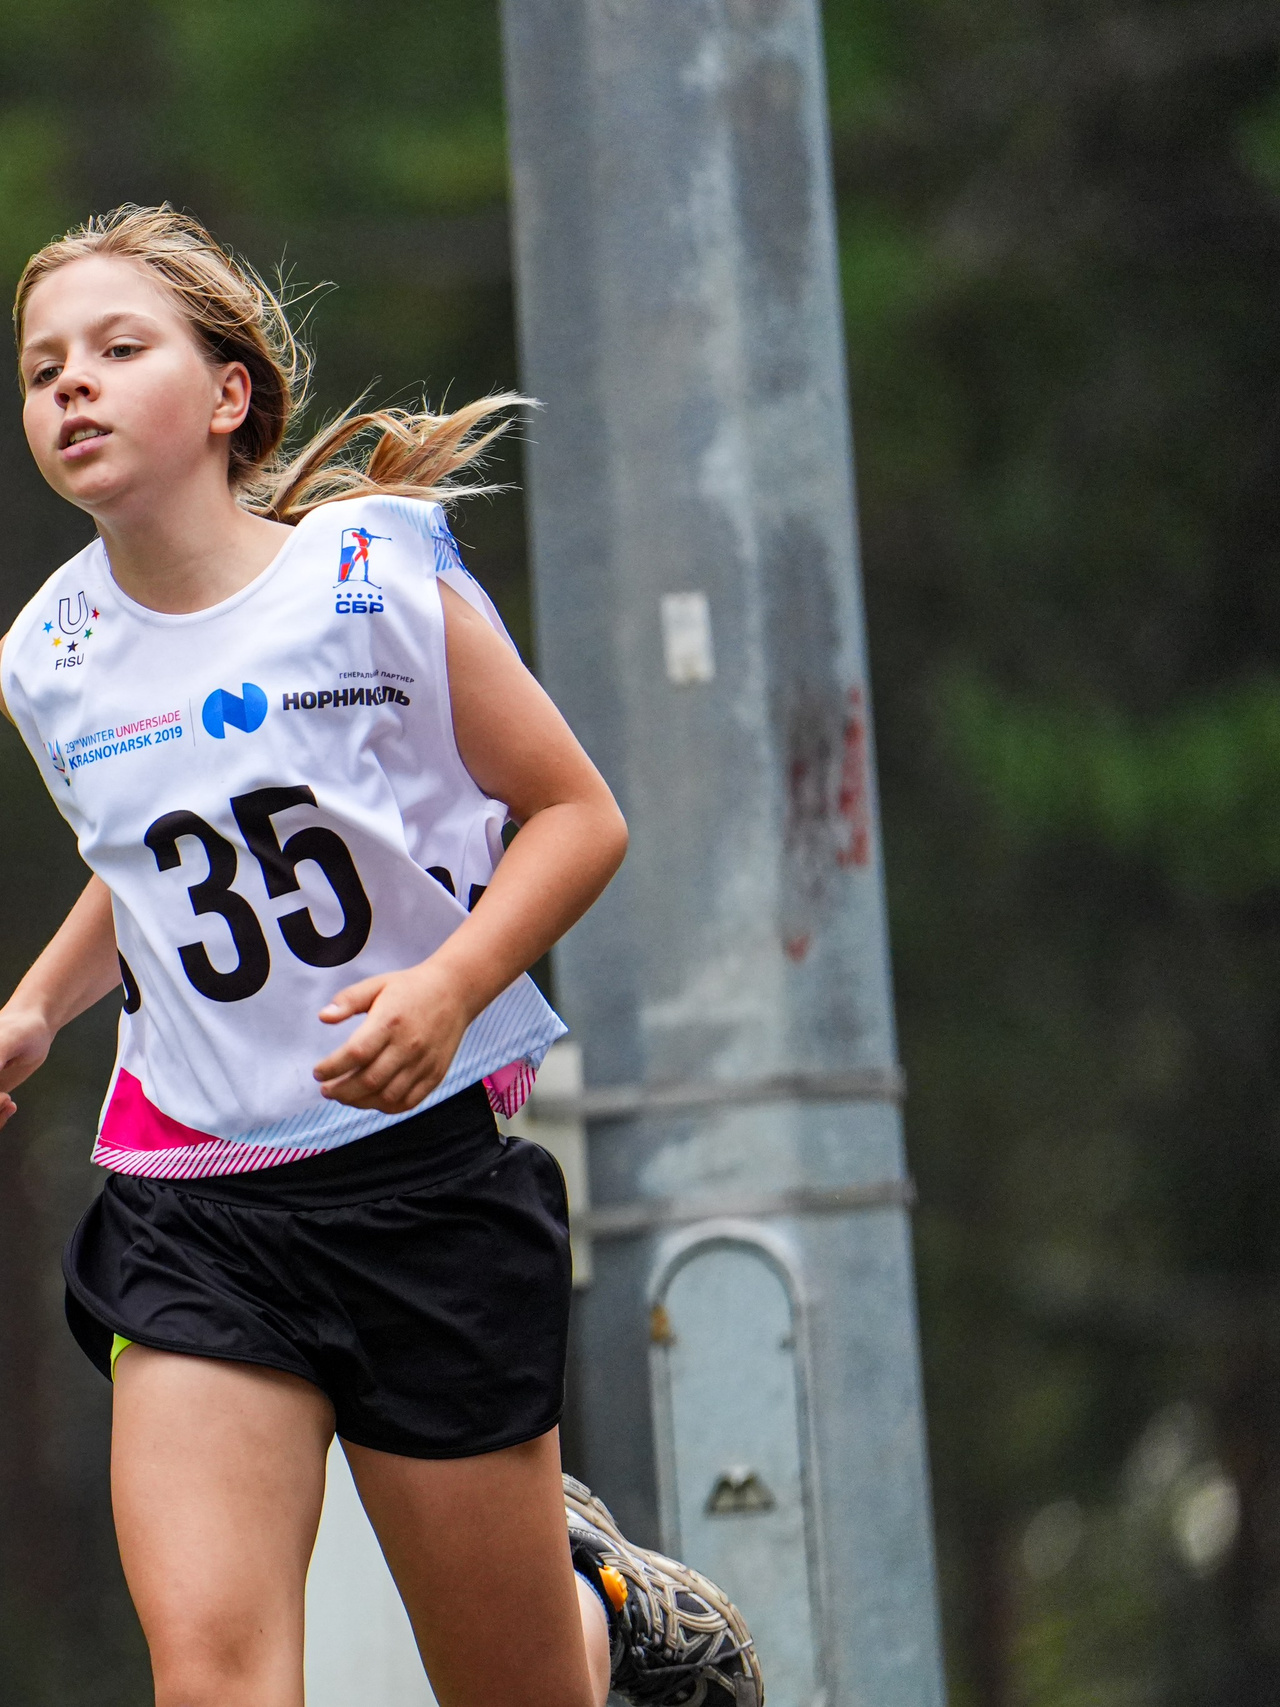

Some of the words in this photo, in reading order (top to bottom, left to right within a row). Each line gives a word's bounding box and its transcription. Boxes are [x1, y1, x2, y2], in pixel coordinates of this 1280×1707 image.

[335, 600, 384, 614] СБР
[55, 653, 85, 670] FISU
[380, 671, 415, 684] ПАРТНЕР
[79, 729, 115, 748] WINTER
[115, 710, 181, 738] UNIVERSIADE
[68, 733, 152, 770] KRASNOYARSK
[154, 725, 183, 744] 2019
[143, 784, 373, 1002] 35
